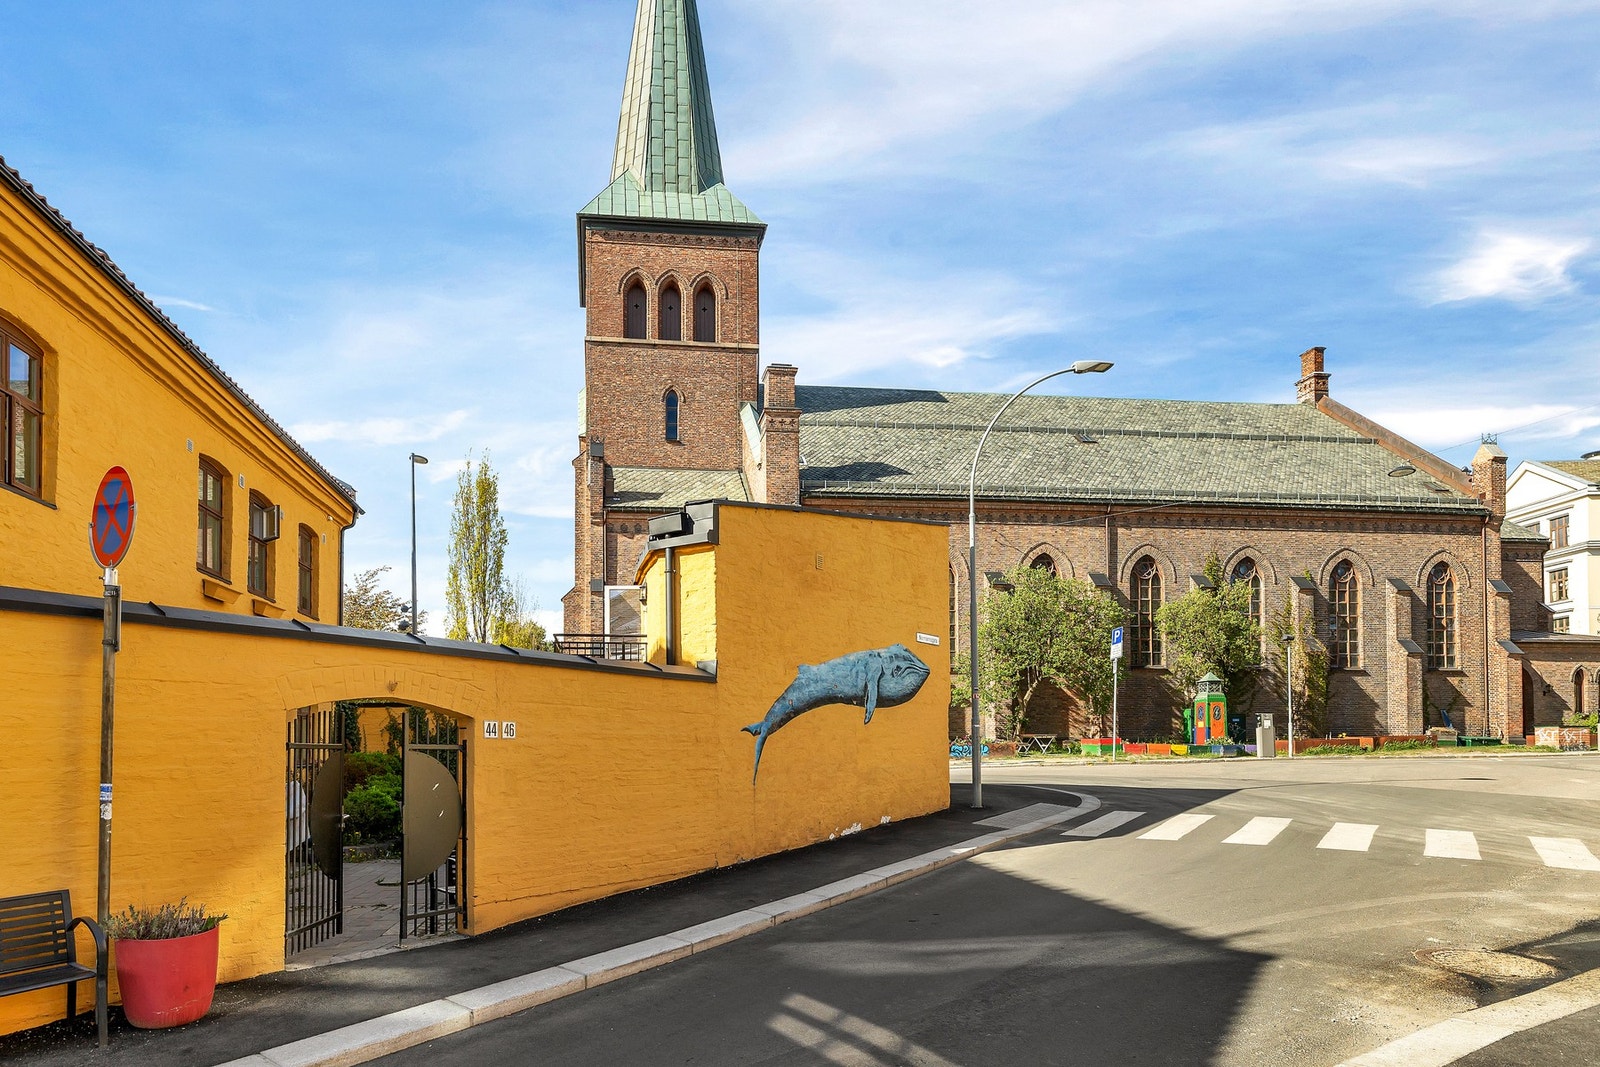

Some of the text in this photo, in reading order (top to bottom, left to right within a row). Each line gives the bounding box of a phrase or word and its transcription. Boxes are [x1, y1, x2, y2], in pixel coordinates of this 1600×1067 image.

[1114, 630, 1121, 643] P
[485, 722, 515, 737] 44 46
